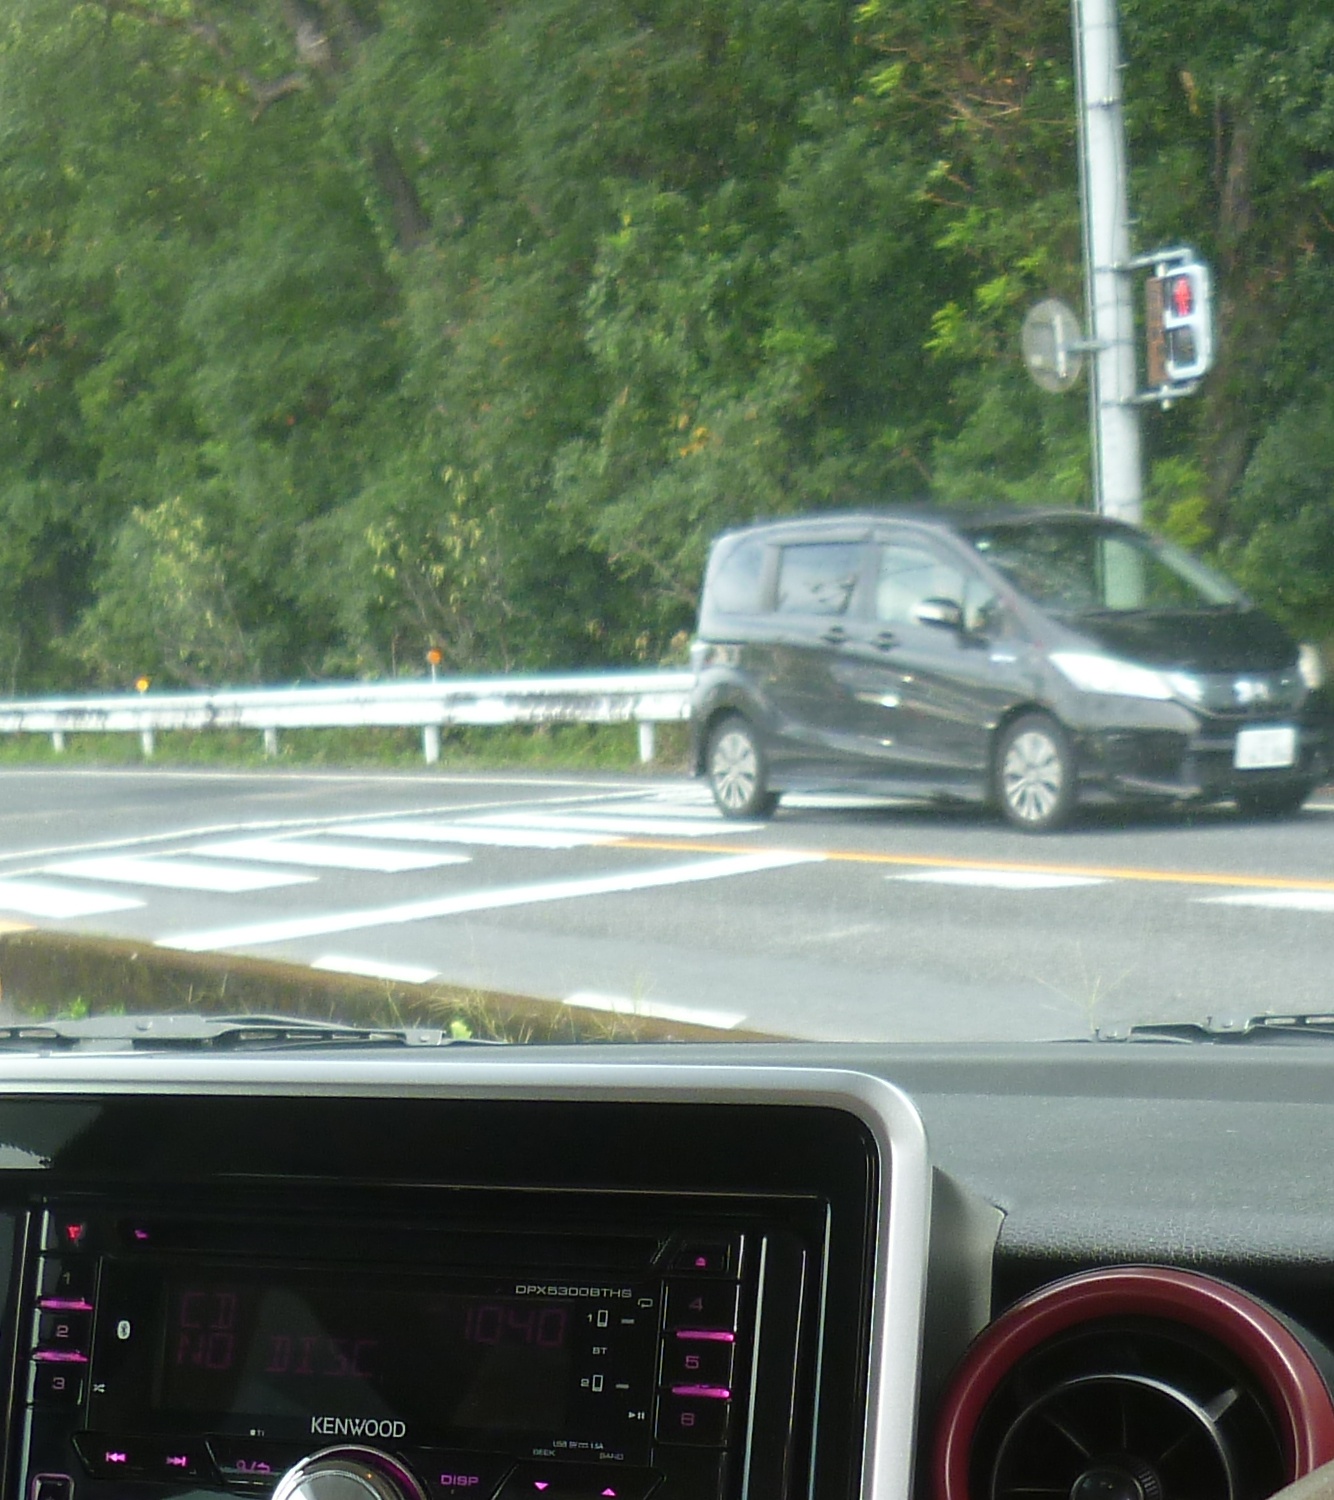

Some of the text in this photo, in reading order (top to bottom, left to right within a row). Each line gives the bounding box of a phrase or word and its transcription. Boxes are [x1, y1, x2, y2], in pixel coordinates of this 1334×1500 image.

[688, 1296, 704, 1312] 4
[56, 1324, 70, 1339] 2
[684, 1355, 700, 1370] 5
[51, 1377, 66, 1391] 3
[310, 1415, 407, 1438] KENWOOD
[440, 1473, 480, 1487] DISP
